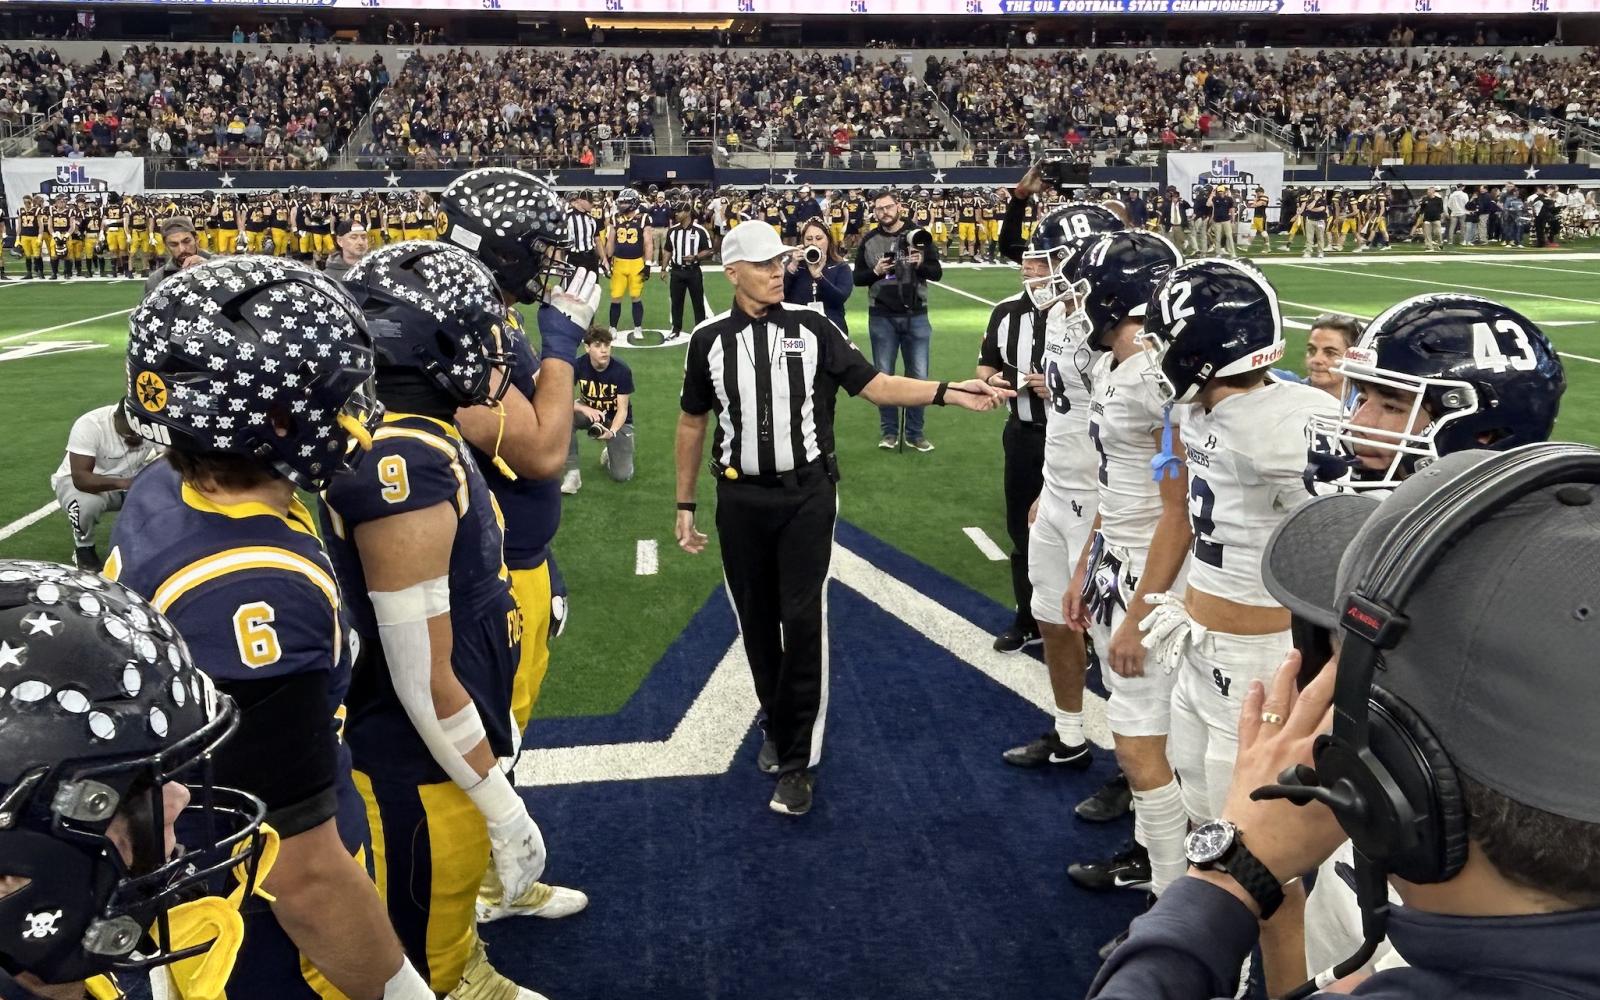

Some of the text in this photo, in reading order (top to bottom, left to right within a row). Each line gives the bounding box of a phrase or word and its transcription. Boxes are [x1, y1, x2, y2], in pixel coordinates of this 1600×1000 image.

[850, 1, 868, 12] UIL
[966, 1, 983, 12] UIL
[1006, 0, 1279, 11] THE UIL FOOTBALL STATE CHAMPIONSHIPS
[1303, 0, 1321, 12] UIL
[1415, 0, 1433, 11] UIL
[1531, 0, 1550, 11] UIL
[56, 163, 91, 184] UIL
[1211, 158, 1239, 177] UIL
[52, 185, 96, 193] FOOTBALL
[617, 227, 639, 244] 93
[1059, 213, 1092, 241] 18
[1159, 280, 1196, 326] 12
[1472, 319, 1538, 374] 43
[579, 379, 618, 398] TAKE
[377, 454, 411, 504] 9
[232, 601, 282, 669] 6
